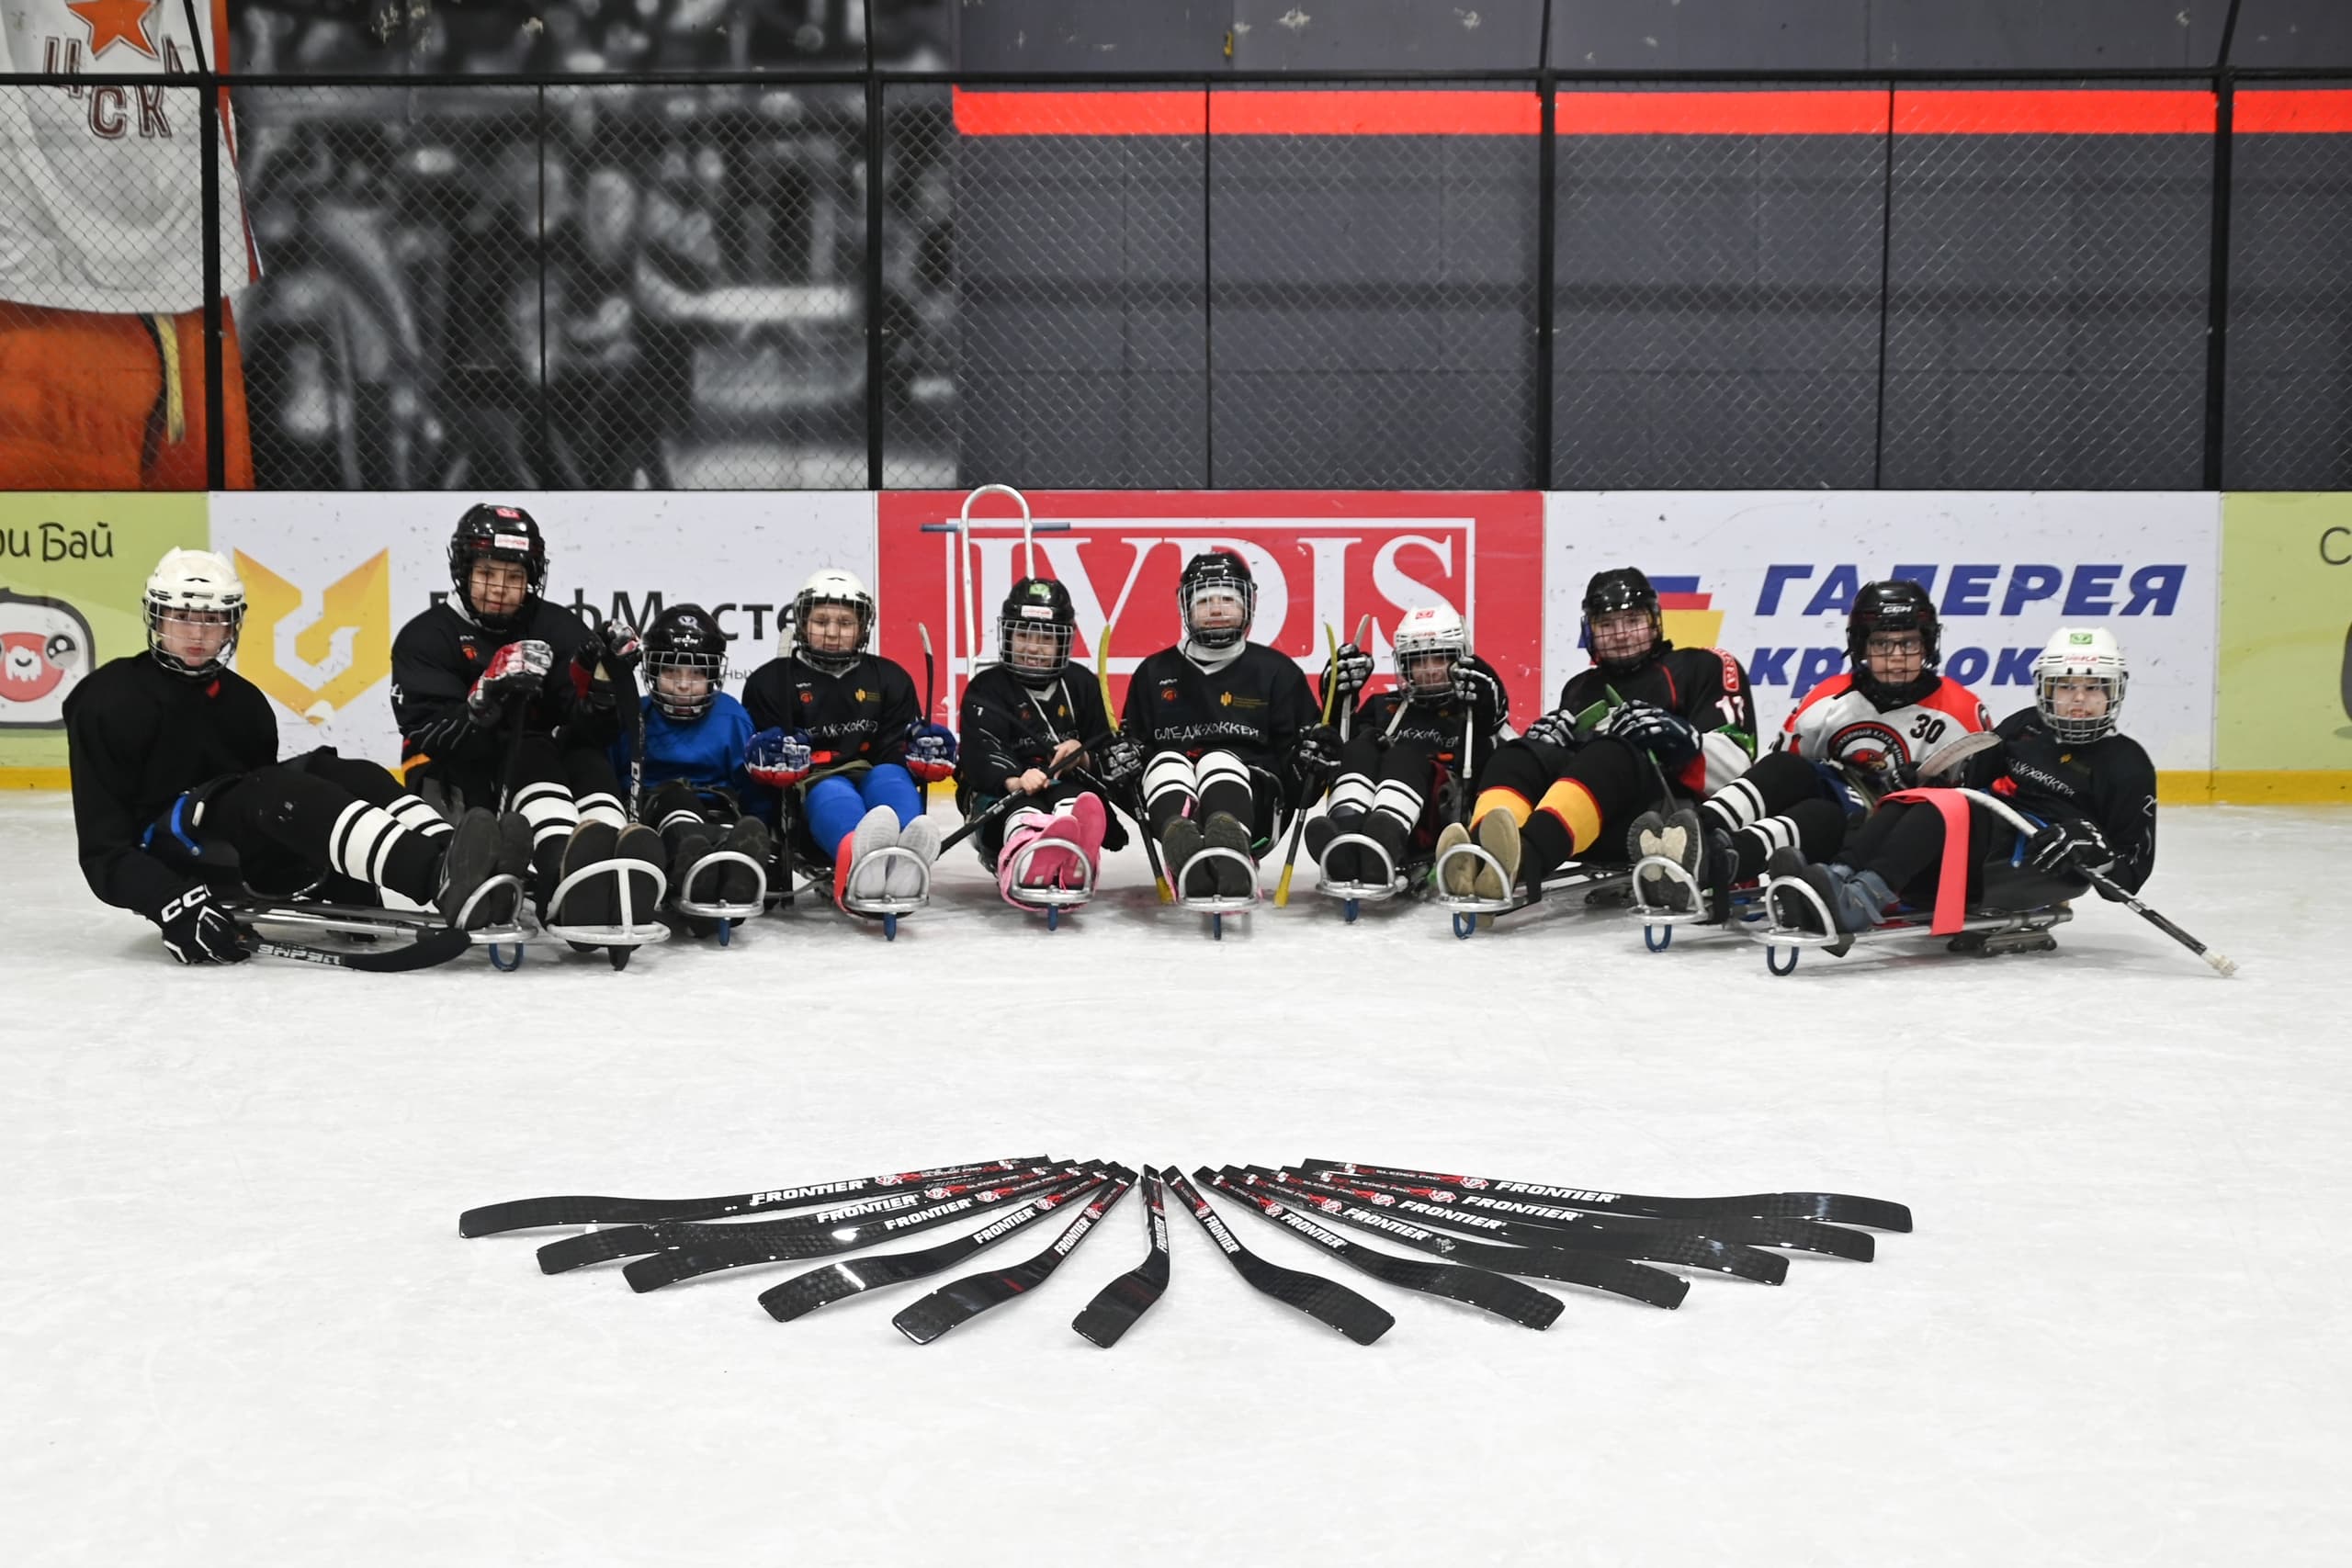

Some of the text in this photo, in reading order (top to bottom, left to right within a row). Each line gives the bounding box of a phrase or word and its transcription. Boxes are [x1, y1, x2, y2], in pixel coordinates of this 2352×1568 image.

[39, 521, 113, 562] Бай
[1910, 714, 1946, 745] 30
[161, 885, 211, 922] CC
[750, 1179, 865, 1206] FRONTIER
[1495, 1180, 1618, 1203] FRONTIER
[817, 1195, 919, 1223] FRONTIER
[884, 1198, 968, 1230] FRONTIER
[1342, 1207, 1429, 1240] FRONTIER
[1398, 1200, 1502, 1230] FRONTIER
[1462, 1195, 1579, 1221] FRONTIER
[973, 1208, 1035, 1245] FRONTIER
[1054, 1216, 1091, 1257] FRONTIER
[1204, 1214, 1239, 1254] FRONTIER
[1280, 1213, 1344, 1248] FRONTIER
